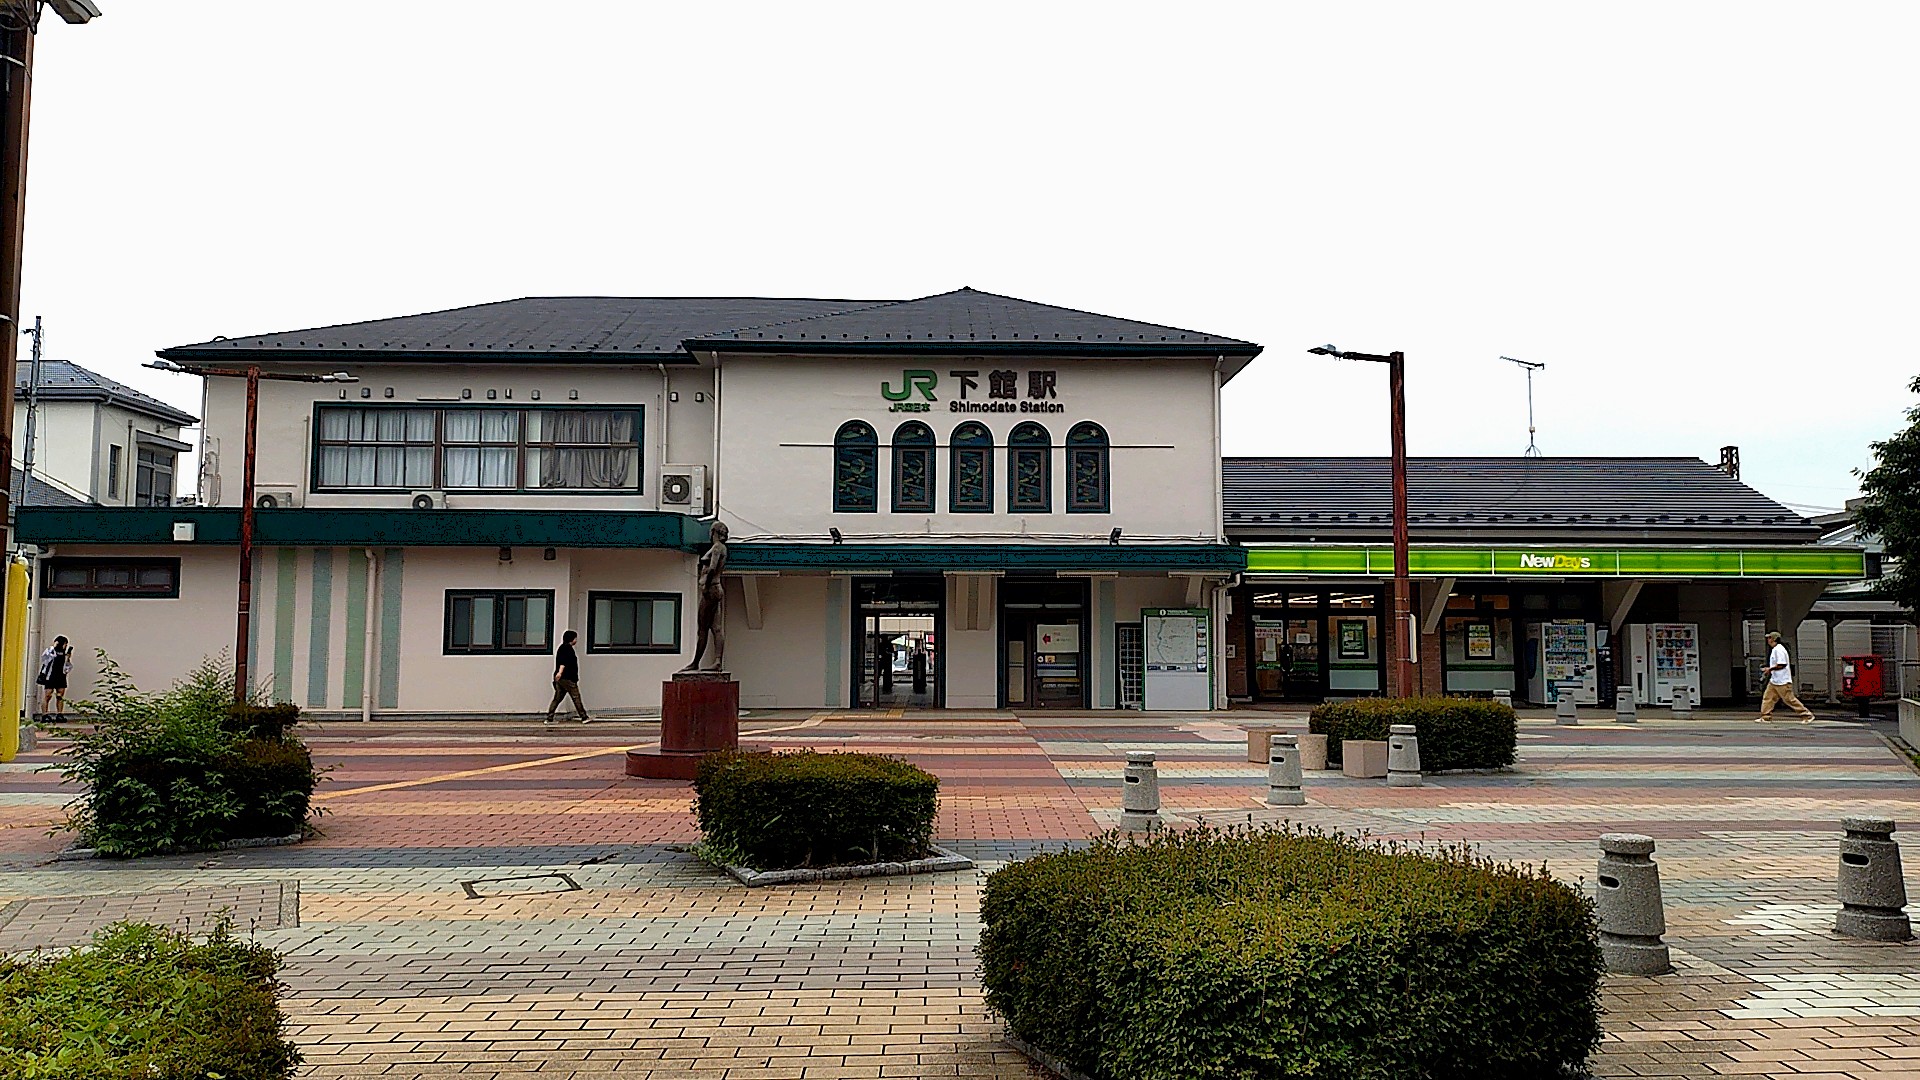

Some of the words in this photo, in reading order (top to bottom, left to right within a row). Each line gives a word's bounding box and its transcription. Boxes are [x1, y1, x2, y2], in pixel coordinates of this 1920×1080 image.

[881, 369, 938, 401] JR
[950, 370, 1057, 399] 下館駅
[950, 401, 1017, 413] Shimodate
[1019, 401, 1064, 413] Station
[1520, 553, 1591, 570] NewDays
